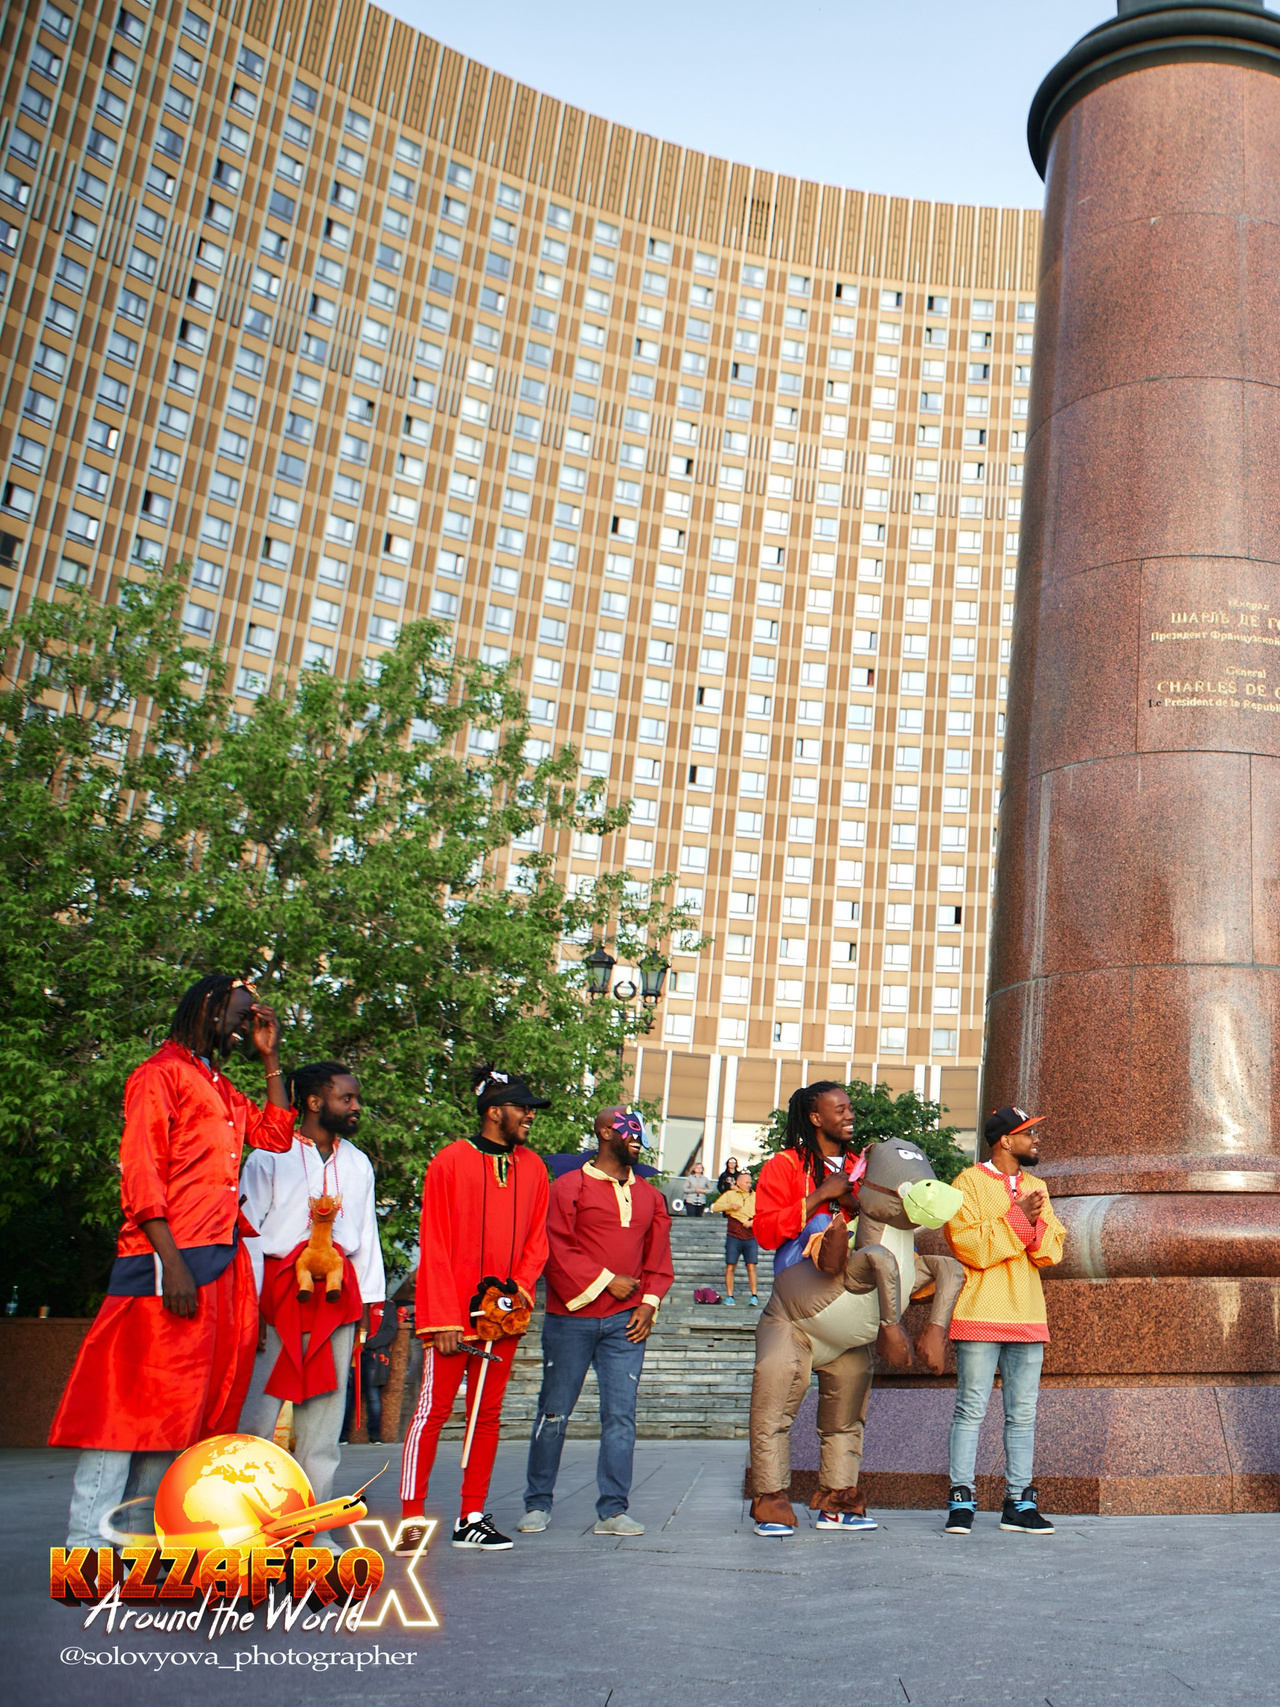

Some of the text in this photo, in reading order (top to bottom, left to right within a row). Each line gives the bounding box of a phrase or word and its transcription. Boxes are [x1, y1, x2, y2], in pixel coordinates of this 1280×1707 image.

[1170, 611, 1230, 624] ШАРЛЬ
[1237, 613, 1260, 628] ДЕ
[1151, 631, 1208, 643] Президент
[1157, 680, 1238, 694] CHARLES
[1245, 682, 1267, 697] DE
[1215, 698, 1229, 707] de
[1230, 697, 1241, 708] la
